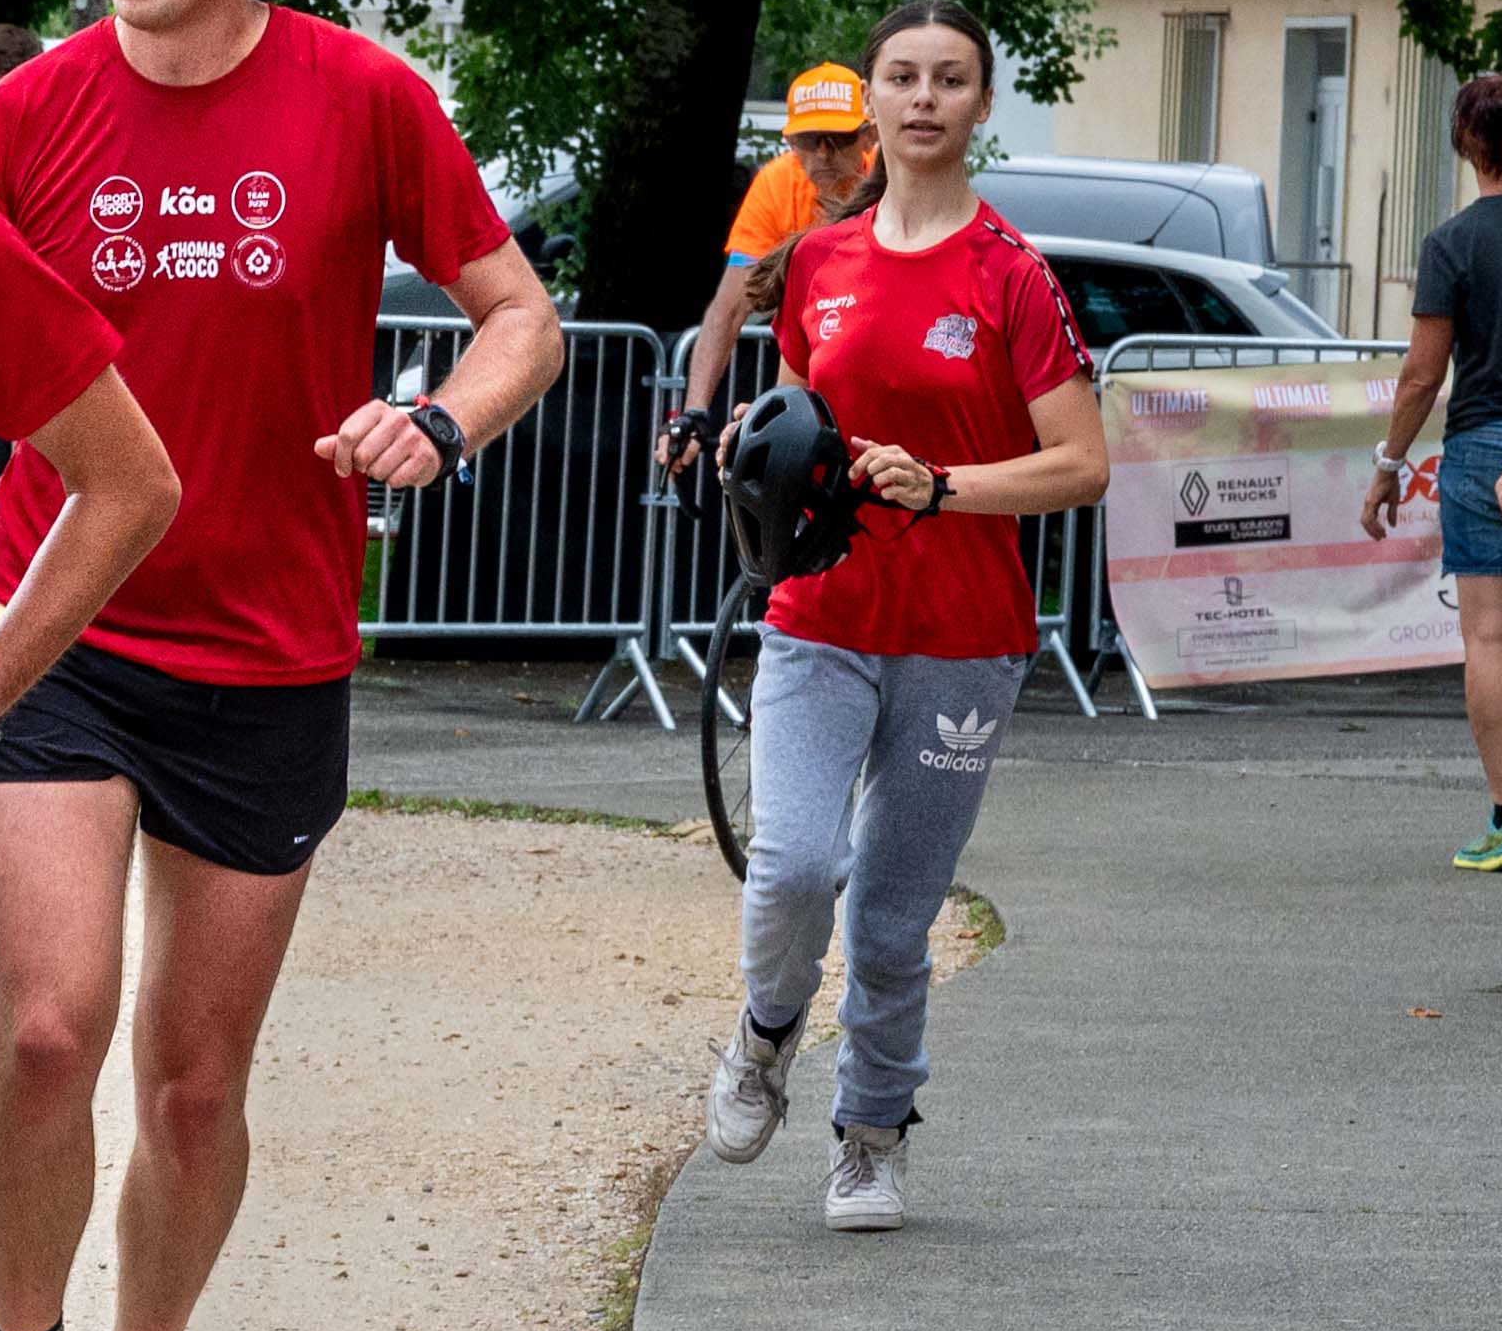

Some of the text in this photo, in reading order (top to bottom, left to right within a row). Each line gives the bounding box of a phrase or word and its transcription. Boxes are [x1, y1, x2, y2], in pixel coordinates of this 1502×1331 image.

[96, 192, 137, 207] SPORT
[99, 204, 133, 216] 2000
[170, 241, 225, 260] THOMAS
[175, 259, 219, 279] COCO
[1131, 389, 1208, 417] ULTIMATE
[1254, 383, 1331, 409] ULTIMATE
[1217, 476, 1284, 491] RENAULT
[1219, 489, 1278, 503] TRUCKS
[1195, 607, 1274, 621] TEC-HOTEL
[919, 749, 986, 772] adidas
